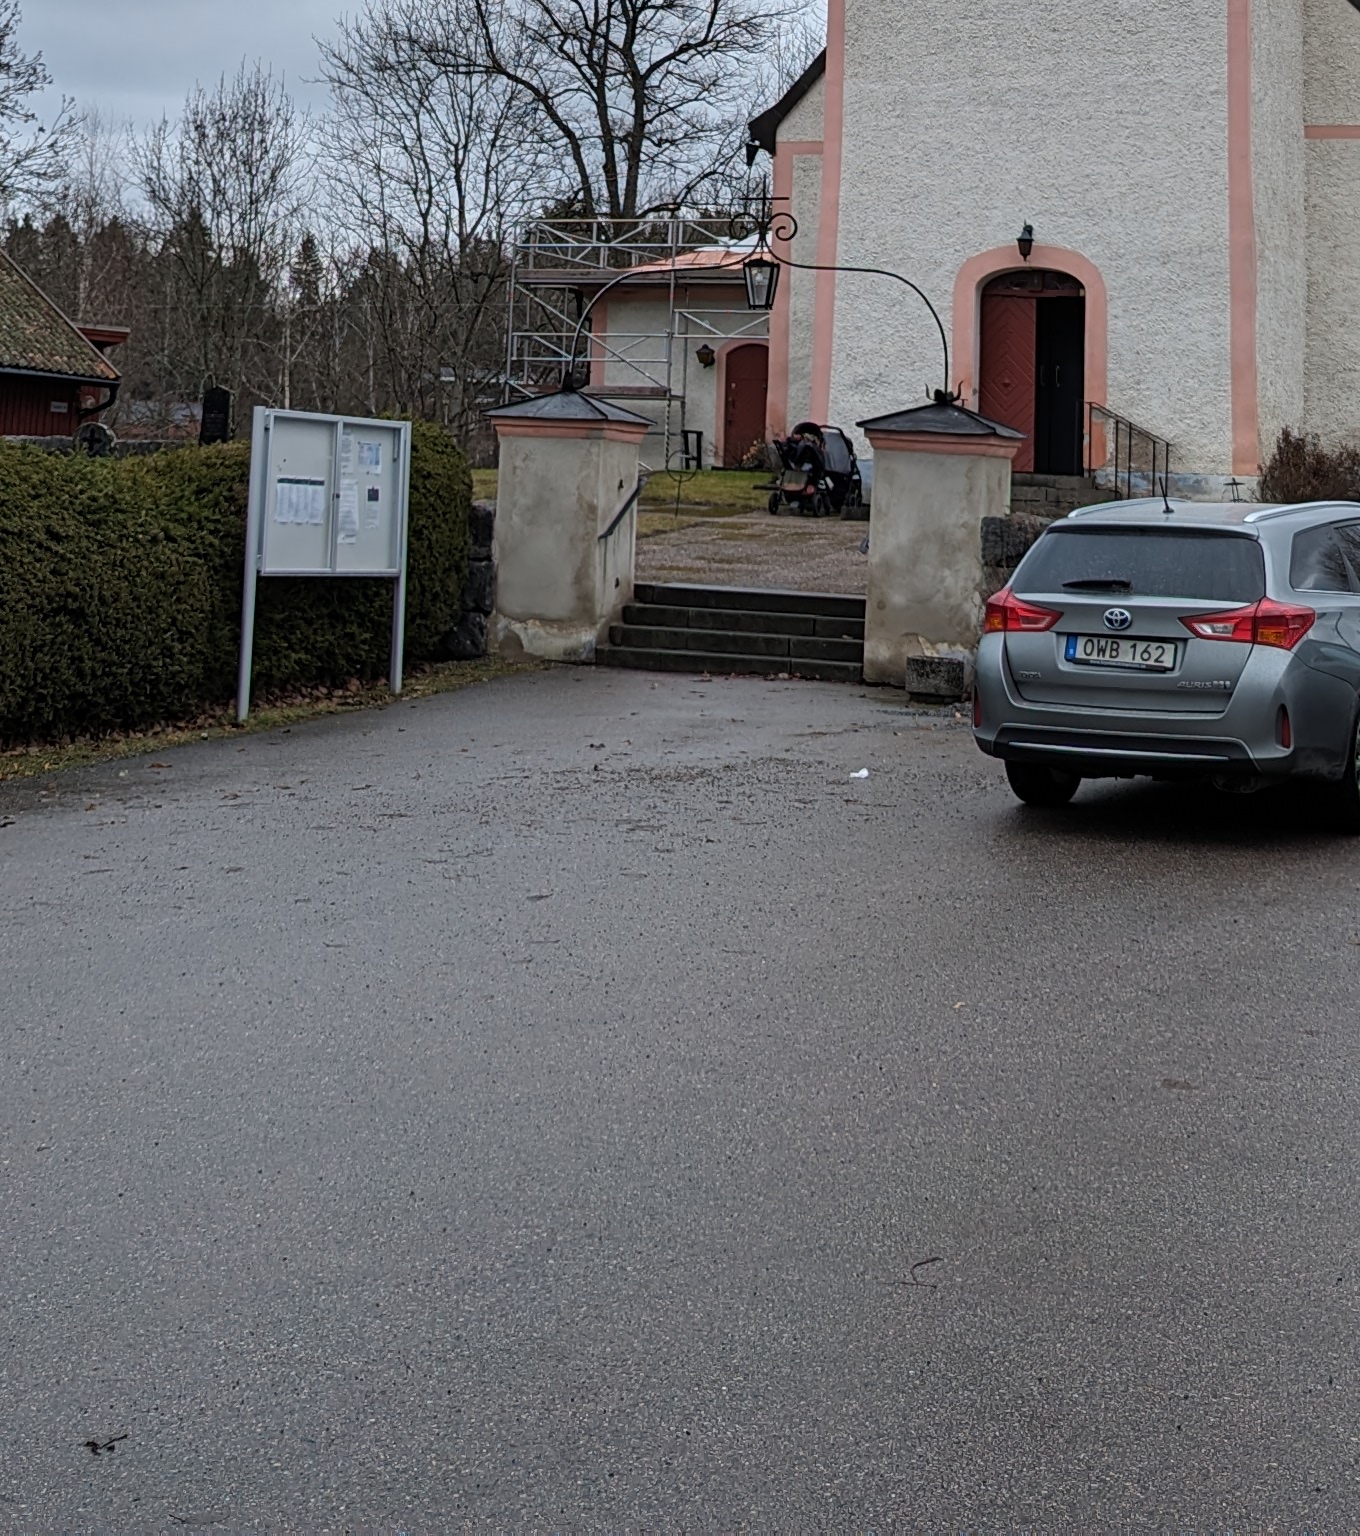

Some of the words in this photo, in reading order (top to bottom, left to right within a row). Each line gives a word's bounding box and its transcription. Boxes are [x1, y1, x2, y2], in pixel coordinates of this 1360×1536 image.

[1083, 638, 1120, 659] OWB
[1129, 643, 1165, 664] 162
[1177, 680, 1212, 689] AURIS
